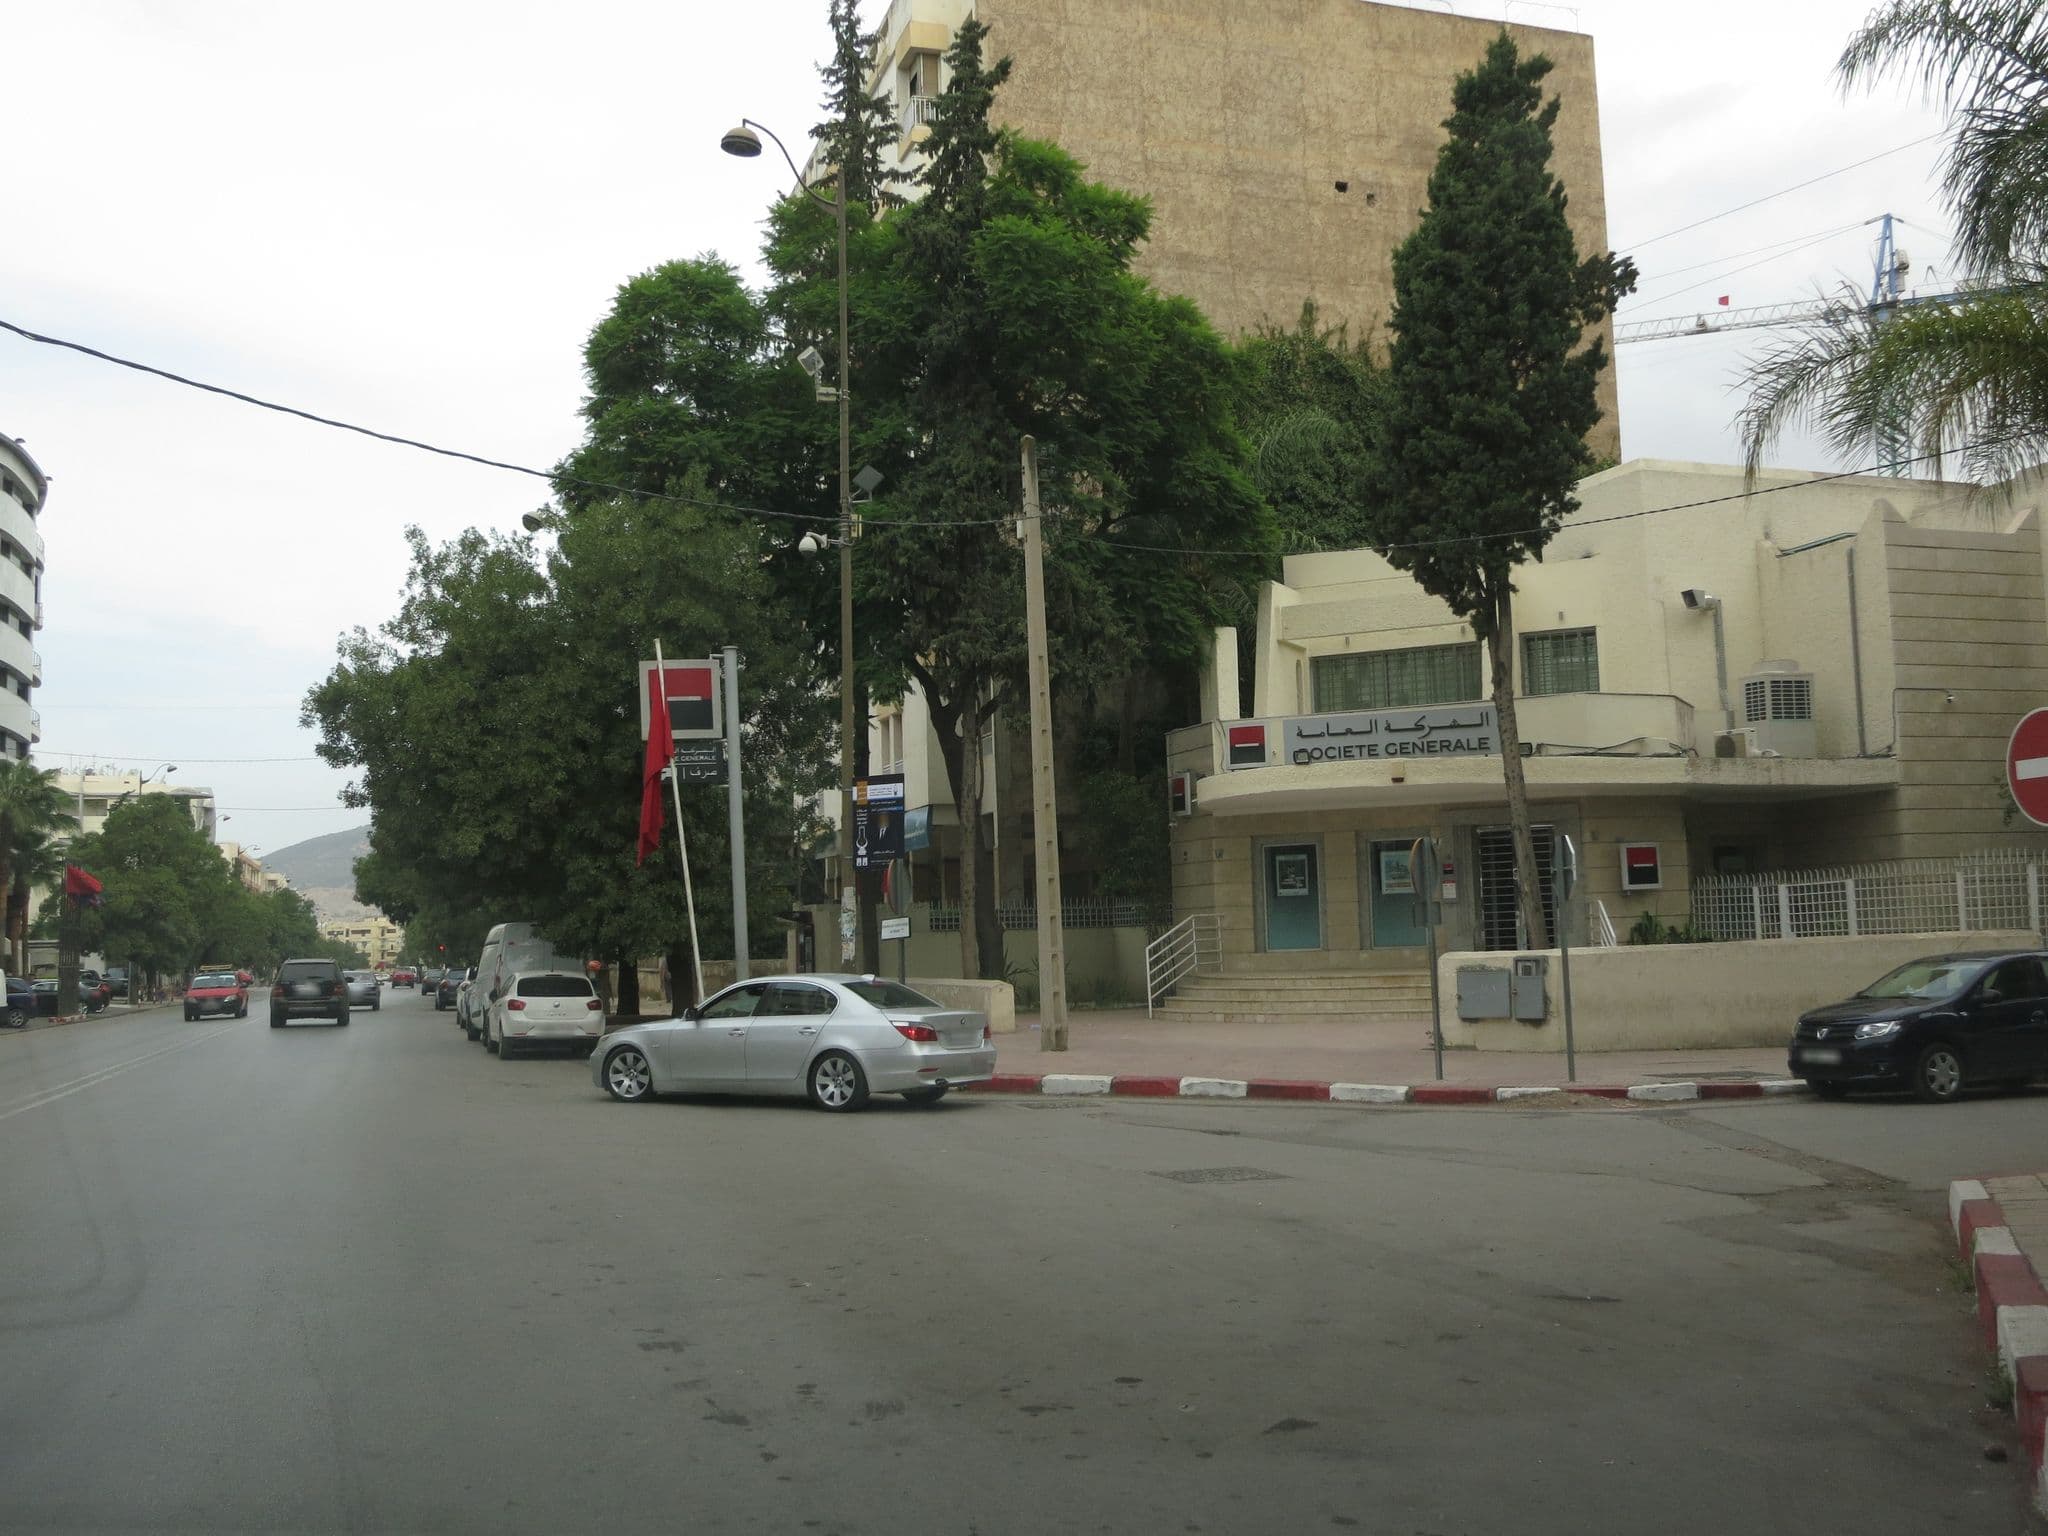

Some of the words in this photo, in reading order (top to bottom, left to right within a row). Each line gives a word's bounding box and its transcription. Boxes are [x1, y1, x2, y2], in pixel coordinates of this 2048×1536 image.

[1296, 718, 1379, 739] العامة
[1384, 711, 1490, 739] الشركة
[1385, 736, 1491, 756] GENERALE
